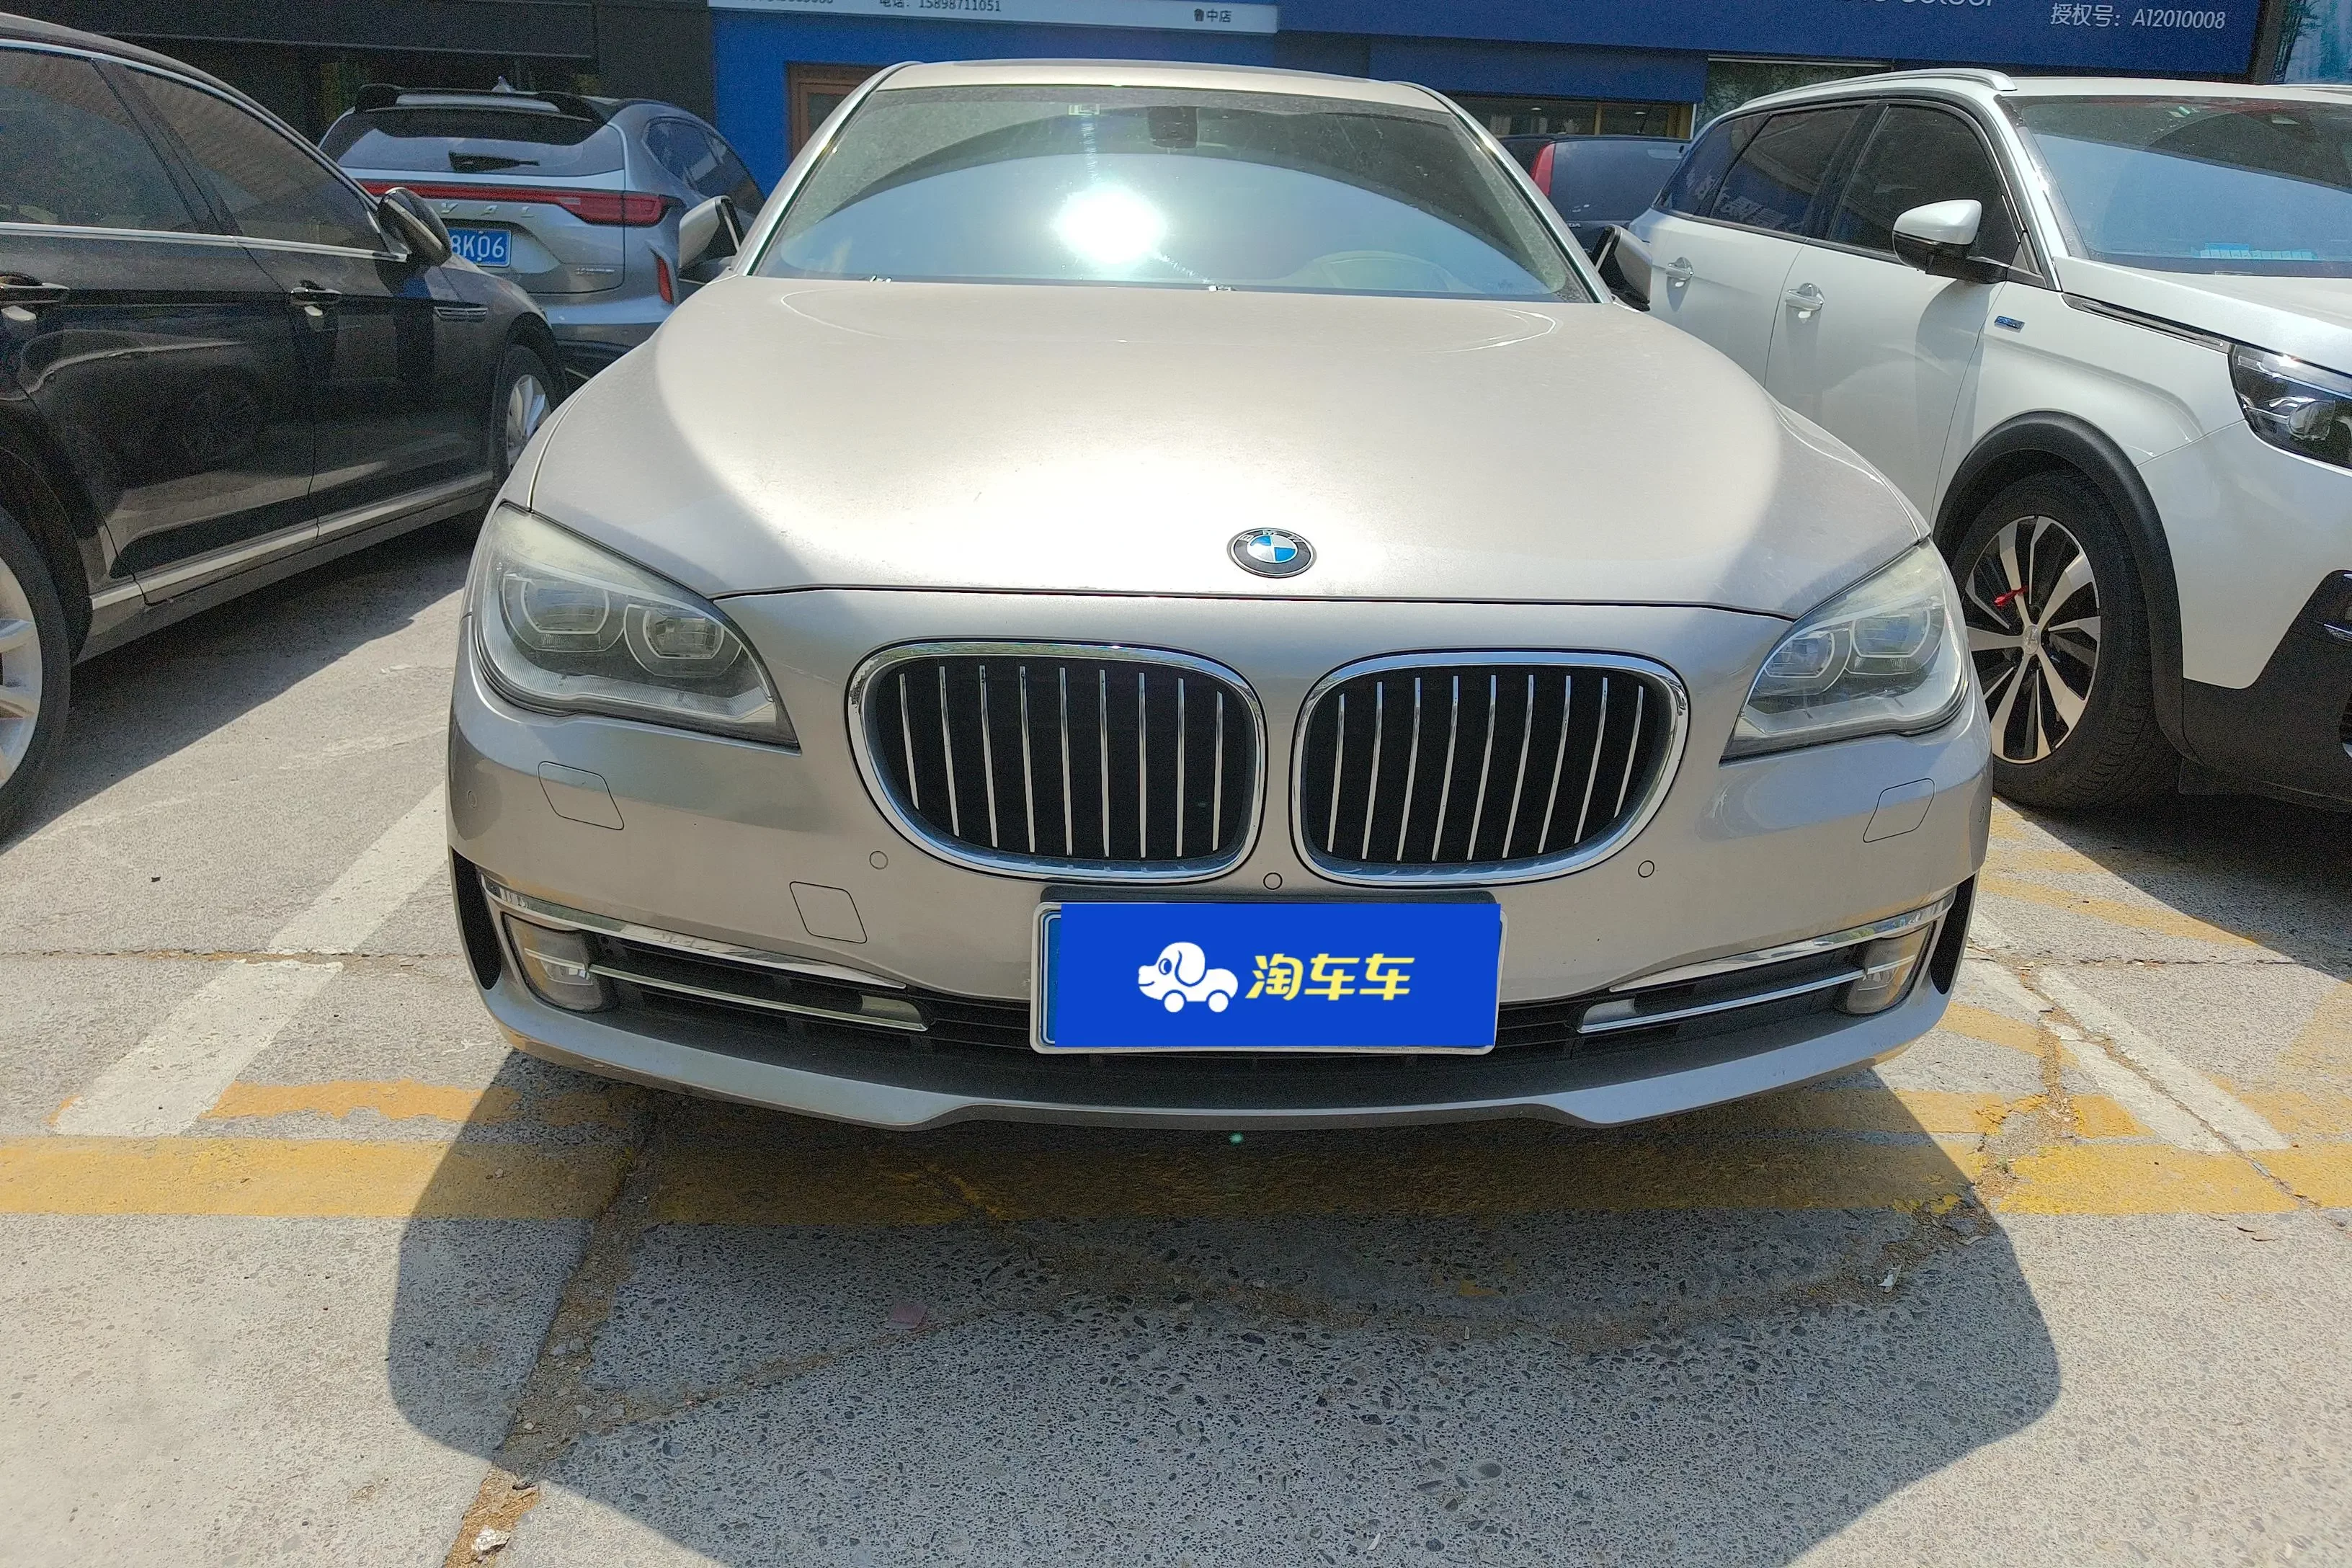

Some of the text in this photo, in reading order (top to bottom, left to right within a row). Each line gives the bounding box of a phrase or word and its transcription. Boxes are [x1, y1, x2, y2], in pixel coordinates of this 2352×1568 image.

[919, 0, 1002, 12] 15898711051
[2050, 2, 2227, 30] 授权号： A12010008
[1239, 529, 1304, 543] BMW
